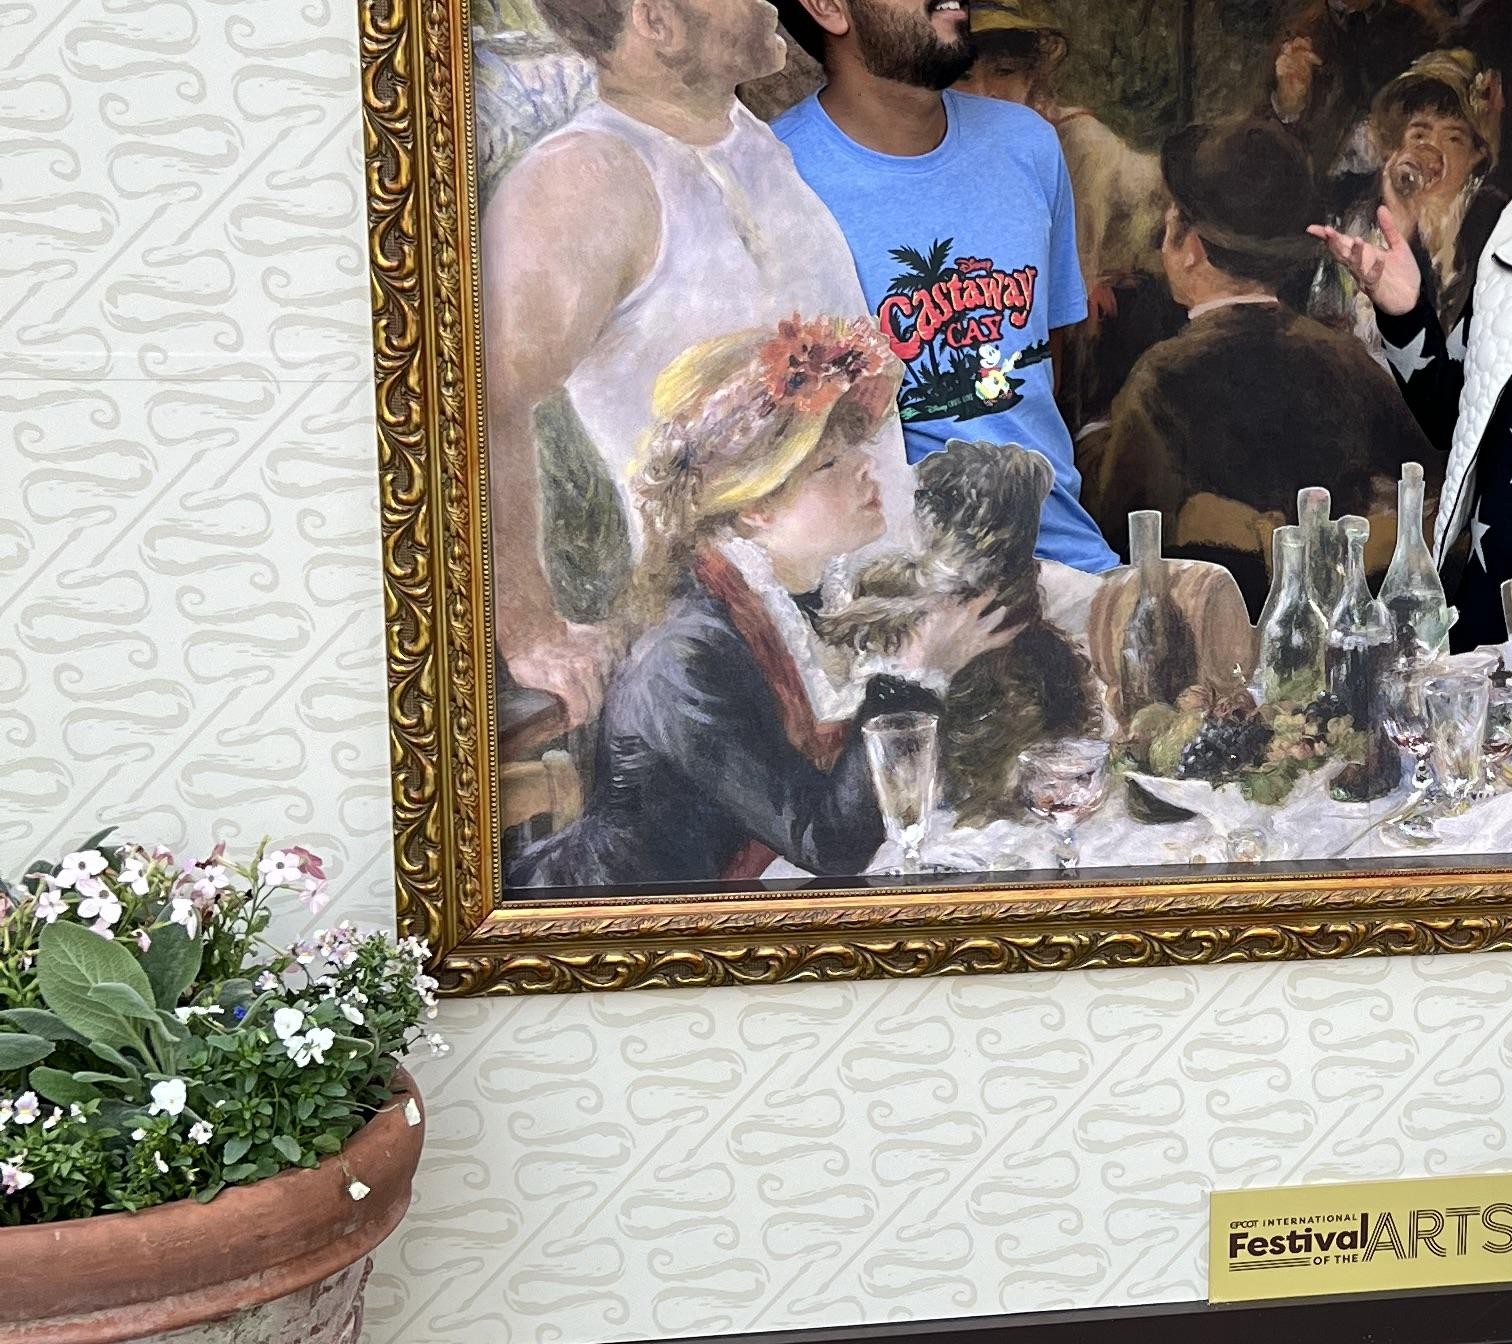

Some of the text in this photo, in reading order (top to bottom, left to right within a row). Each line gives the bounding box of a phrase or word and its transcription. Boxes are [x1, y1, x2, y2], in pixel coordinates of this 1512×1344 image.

[879, 265, 1037, 359] Castaway
[947, 316, 1003, 348] CAY
[1229, 1214, 1358, 1229] EPCOT INTERNATIONAL
[1229, 1212, 1369, 1259] Festival
[1313, 1254, 1359, 1265] OF THE
